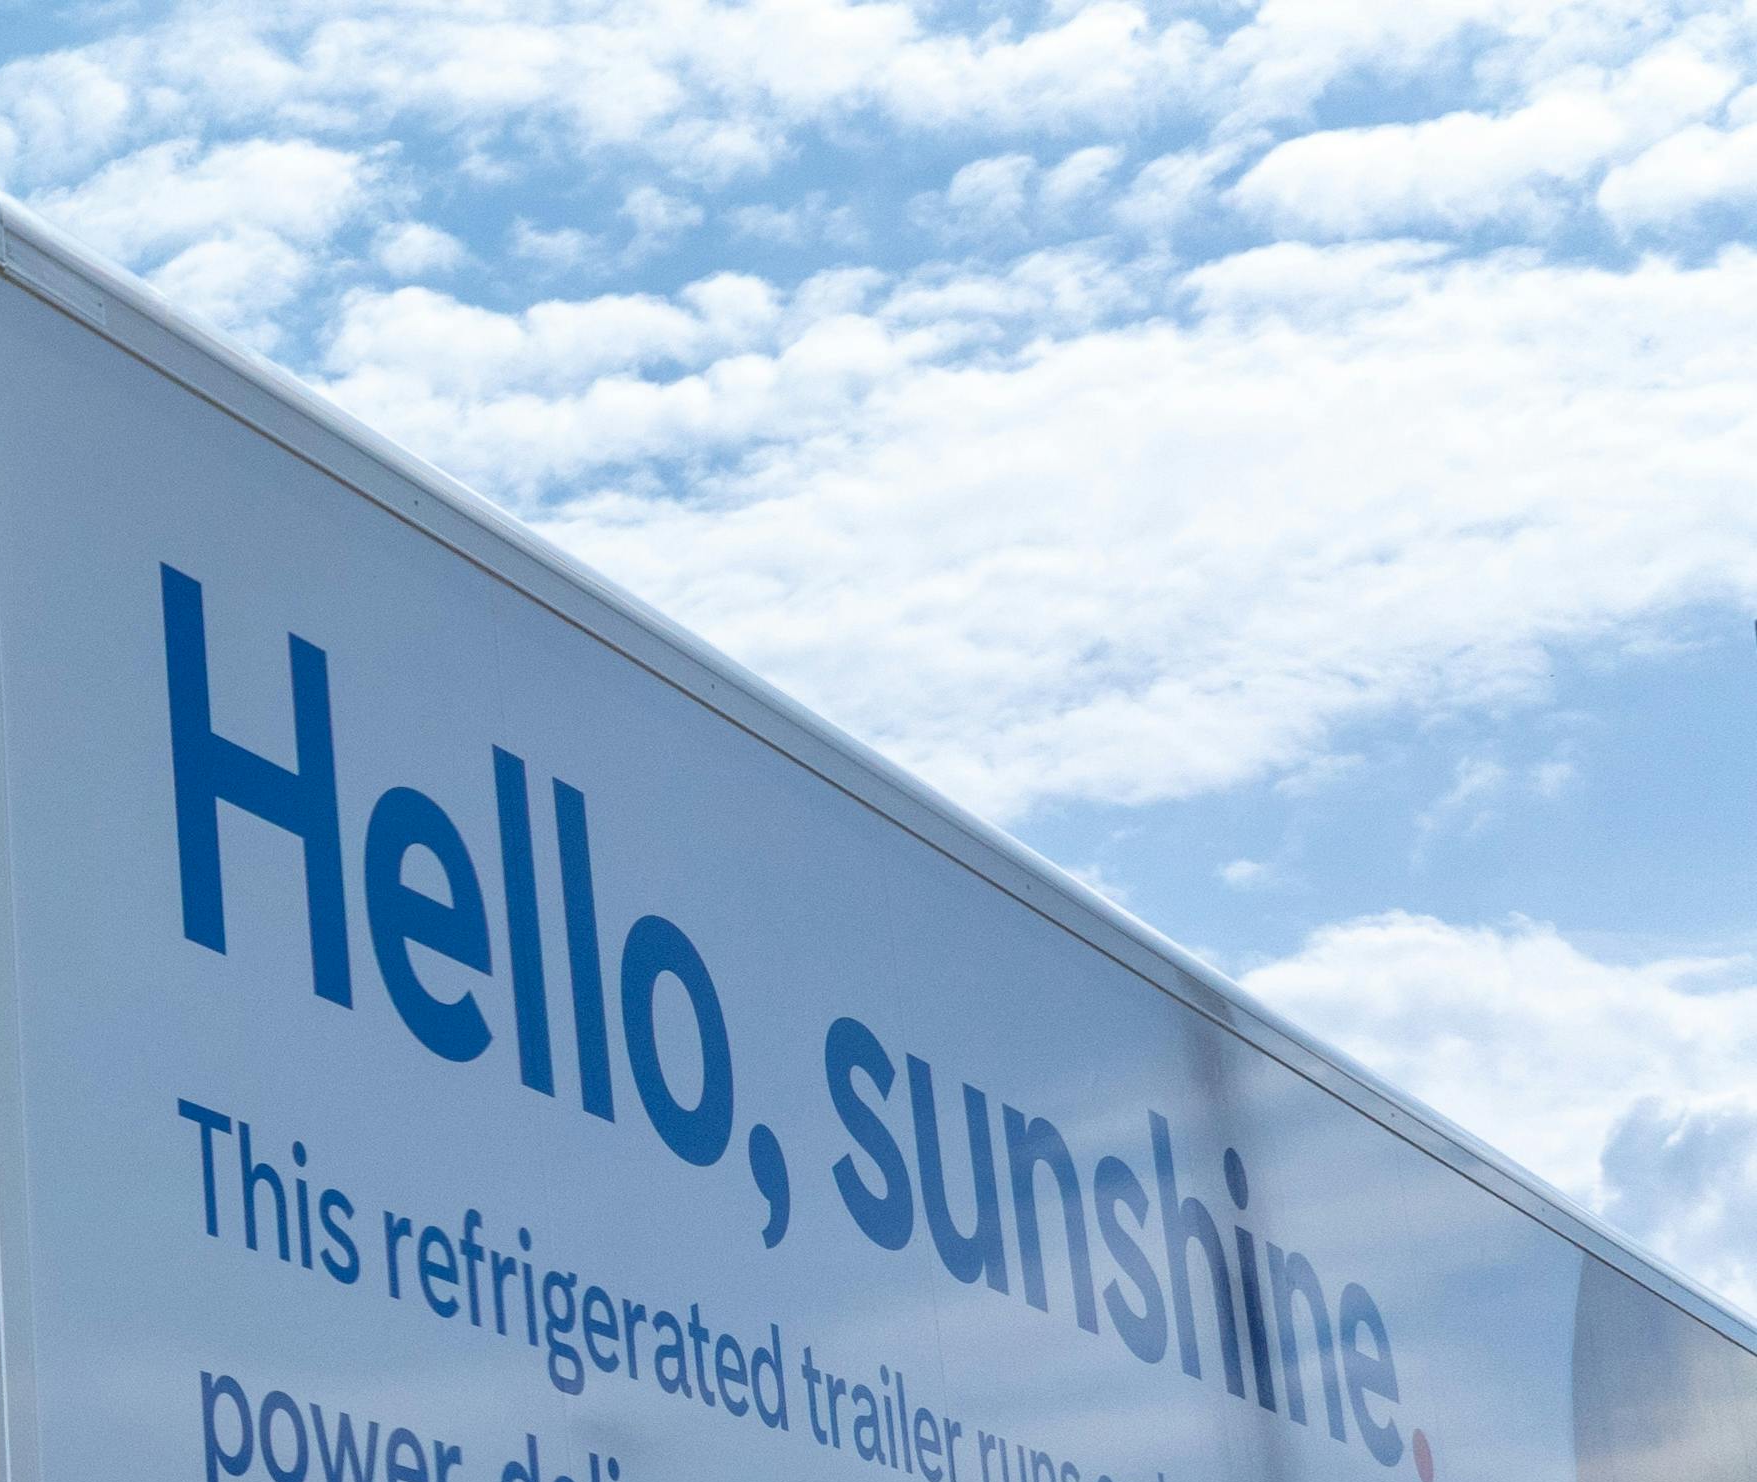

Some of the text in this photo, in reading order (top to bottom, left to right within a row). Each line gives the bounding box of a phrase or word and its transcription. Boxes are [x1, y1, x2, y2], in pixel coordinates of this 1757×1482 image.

[160, 561, 790, 1249] Hello,
[177, 1098, 360, 1285] This
[383, 1209, 789, 1432] refrigerated
